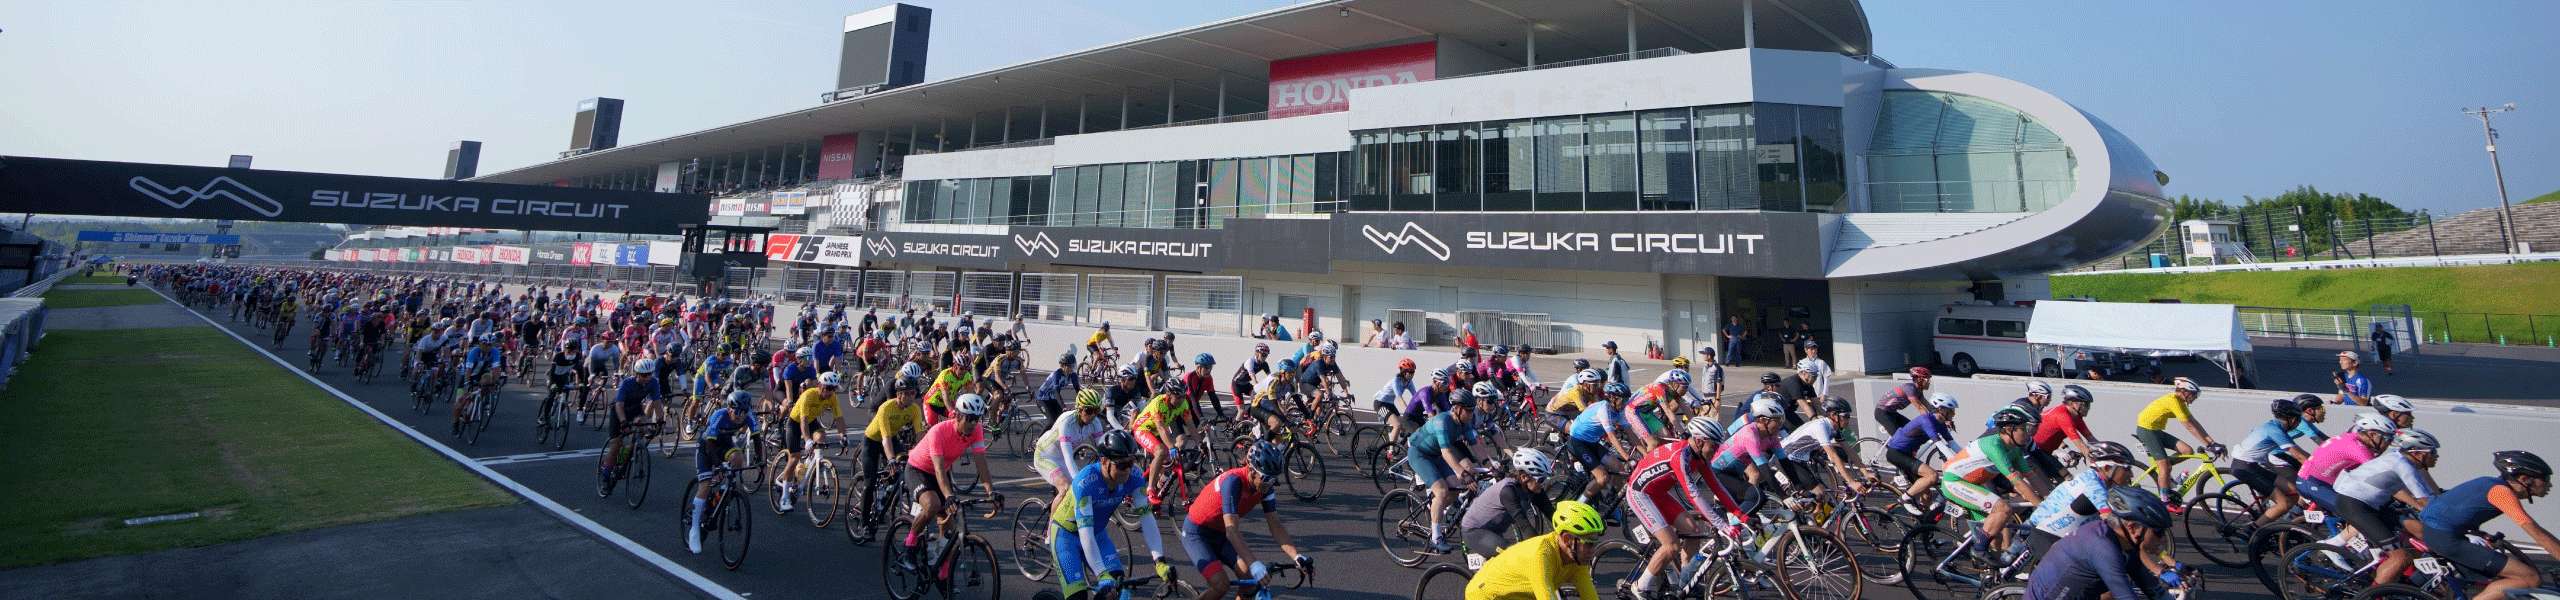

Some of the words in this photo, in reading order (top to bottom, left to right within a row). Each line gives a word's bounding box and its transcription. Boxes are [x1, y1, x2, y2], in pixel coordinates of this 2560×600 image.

[823, 153, 852, 162] NISSAN
[311, 190, 480, 213] SUZUKA
[491, 198, 629, 218] CIRCUIT
[124, 233, 157, 242] Shimano
[189, 235, 208, 243] Road
[1467, 231, 1599, 252] SUZUKA
[1611, 233, 1764, 255] CIRCUIT
[794, 236, 826, 261] 75
[826, 242, 849, 250] JAPANESE
[903, 241, 948, 255] SUZUKA
[951, 245, 1000, 258] CIRCUIT
[1068, 238, 1136, 254] SUZUKA
[1138, 241, 1212, 257] CIRCUIT
[498, 248, 522, 262] HONDA
[573, 246, 589, 263] NGK
[825, 250, 840, 258] GRAND
[1947, 505, 1960, 516] 245
[2308, 513, 2320, 521] 407
[2046, 513, 2076, 532] TOMOS
[1635, 529, 1646, 542] 364
[2419, 561, 2438, 571] 114
